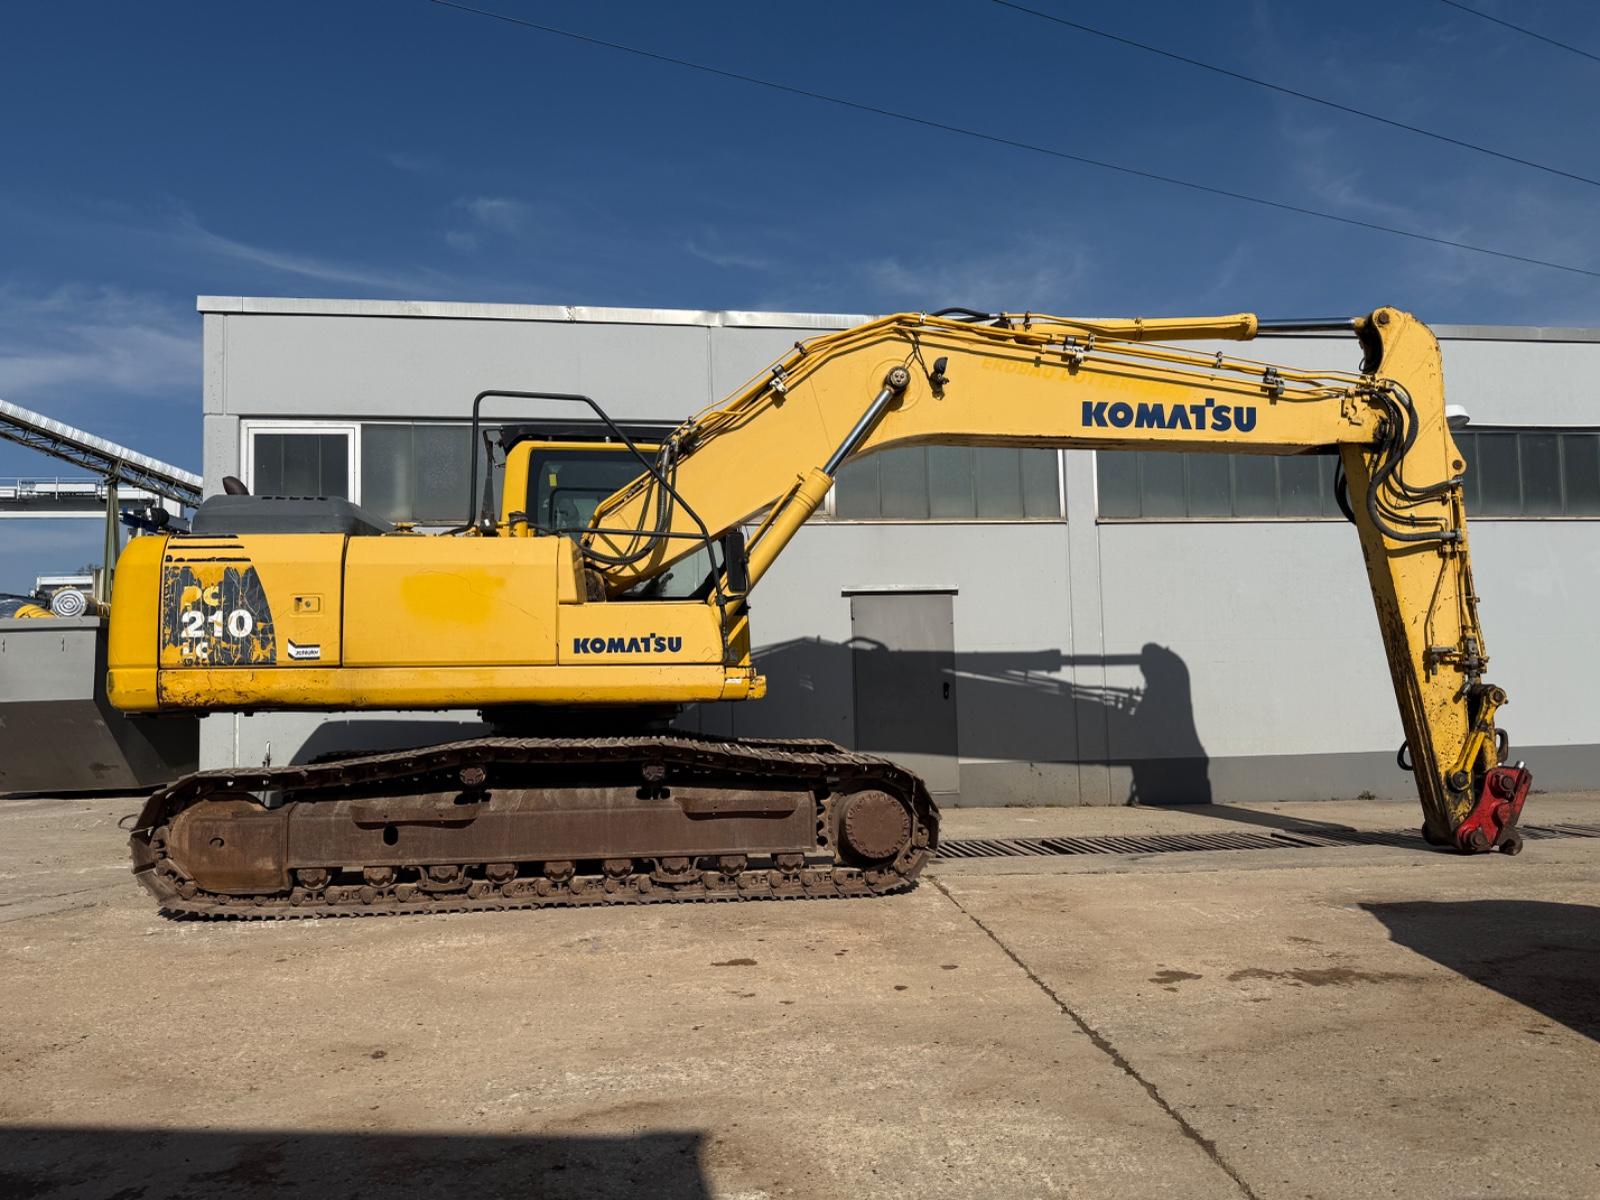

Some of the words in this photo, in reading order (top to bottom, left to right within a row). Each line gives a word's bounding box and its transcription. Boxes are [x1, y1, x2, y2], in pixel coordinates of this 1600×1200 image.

[1082, 398, 1257, 431] KOMATSU
[181, 609, 253, 637] 210
[574, 633, 682, 654] KOMATSU
